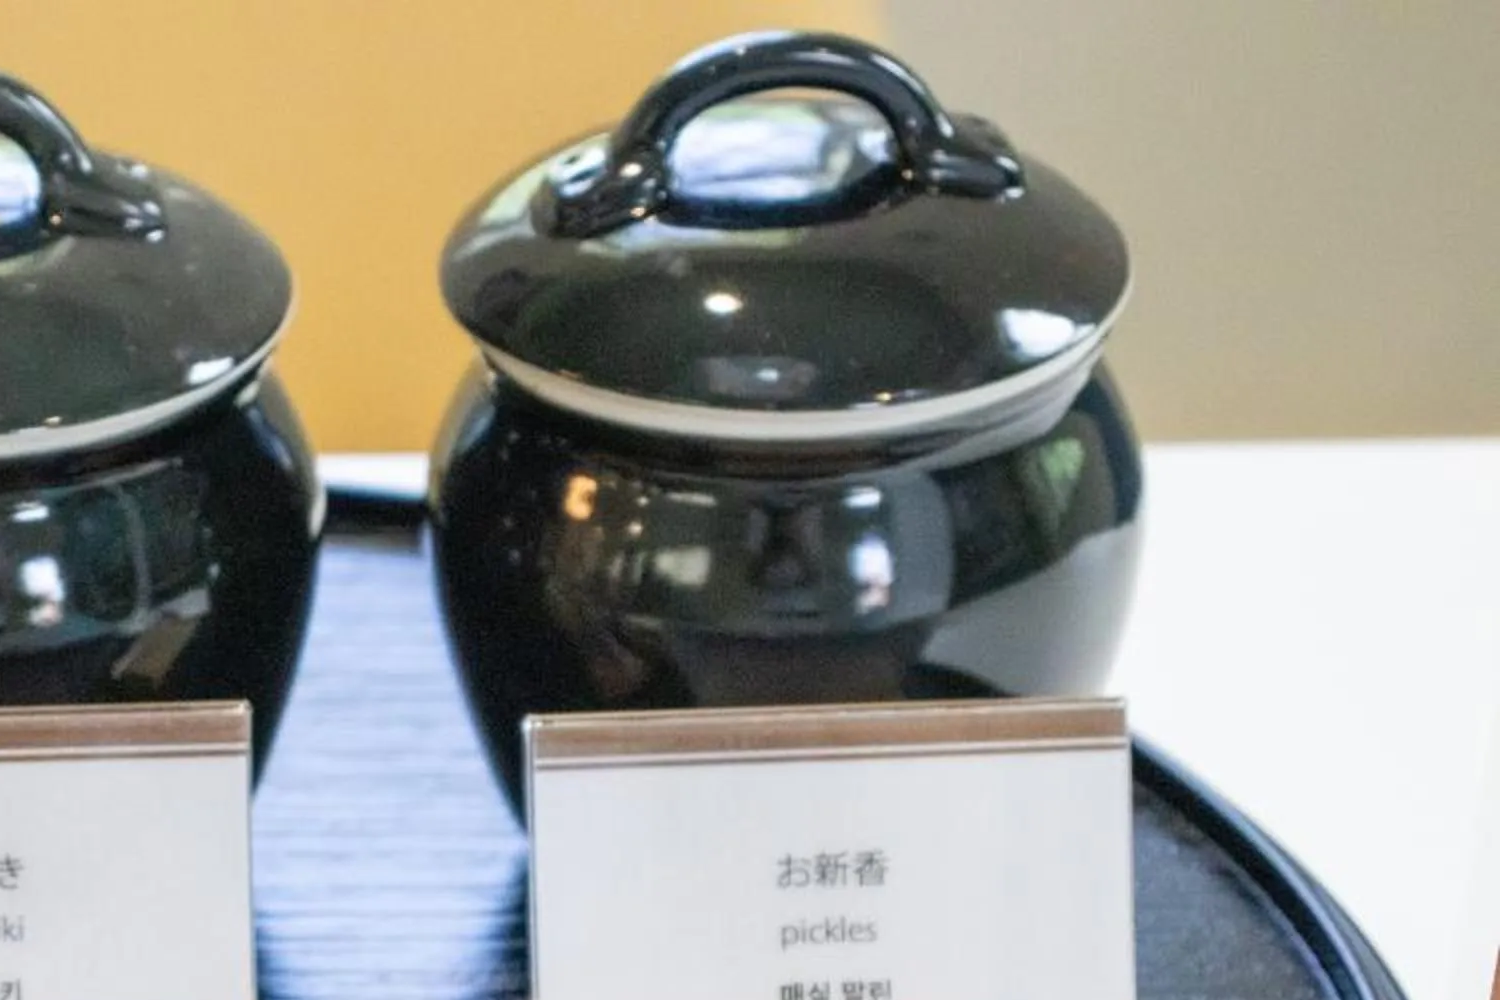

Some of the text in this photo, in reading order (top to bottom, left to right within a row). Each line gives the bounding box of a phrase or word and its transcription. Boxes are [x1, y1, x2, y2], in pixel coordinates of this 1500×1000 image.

[776, 850, 890, 889] お新香
[780, 915, 878, 950] pickles
